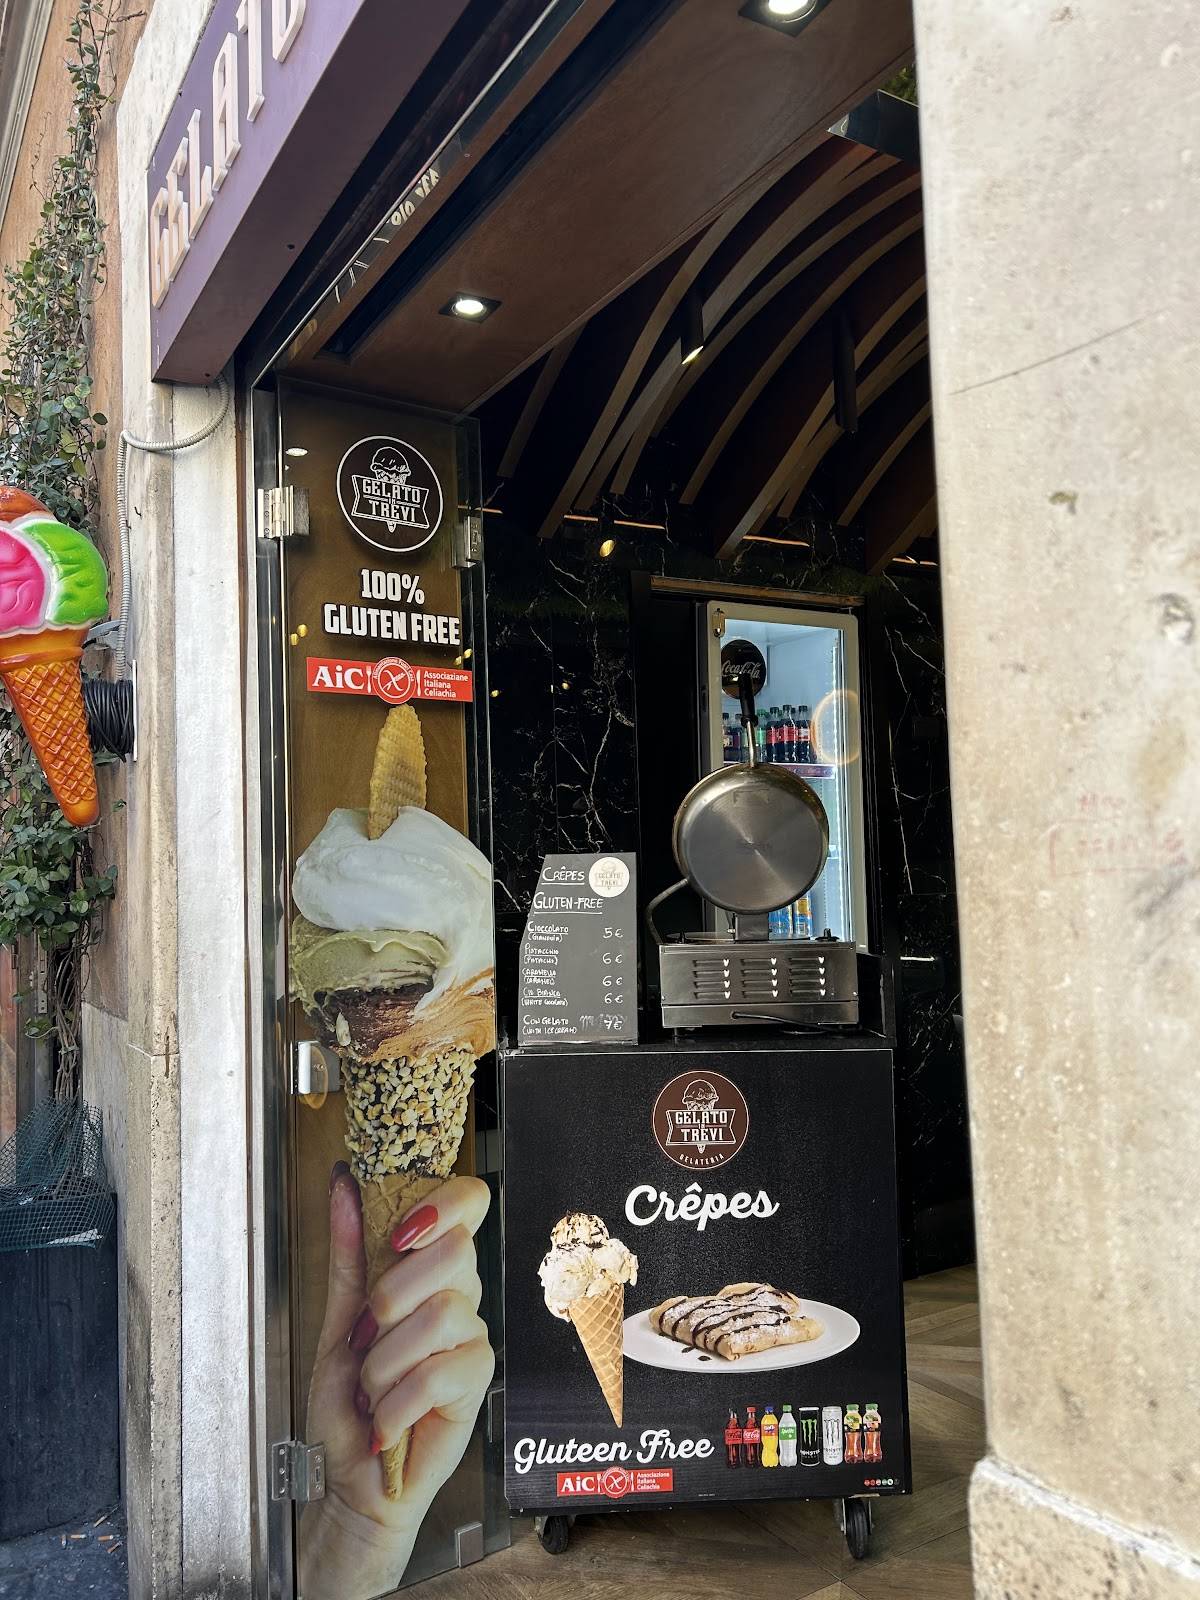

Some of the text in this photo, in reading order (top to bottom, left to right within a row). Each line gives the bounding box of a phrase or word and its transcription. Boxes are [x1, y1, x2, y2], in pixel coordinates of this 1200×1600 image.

[363, 478, 421, 503] GELATO
[368, 500, 416, 522] TREVI
[361, 568, 425, 605] 100%
[323, 604, 461, 645] GLUTEN FREE
[312, 665, 365, 690] AiC
[424, 679, 452, 689] Italiana
[424, 688, 457, 698] Celiachia
[675, 1111, 728, 1125] GELATO
[680, 1128, 724, 1142] TREVI
[679, 1153, 725, 1166] GELATERIA
[624, 1181, 781, 1231] Crêpes
[513, 1428, 716, 1475] Gluteen Free
[560, 1475, 596, 1492] AiC
